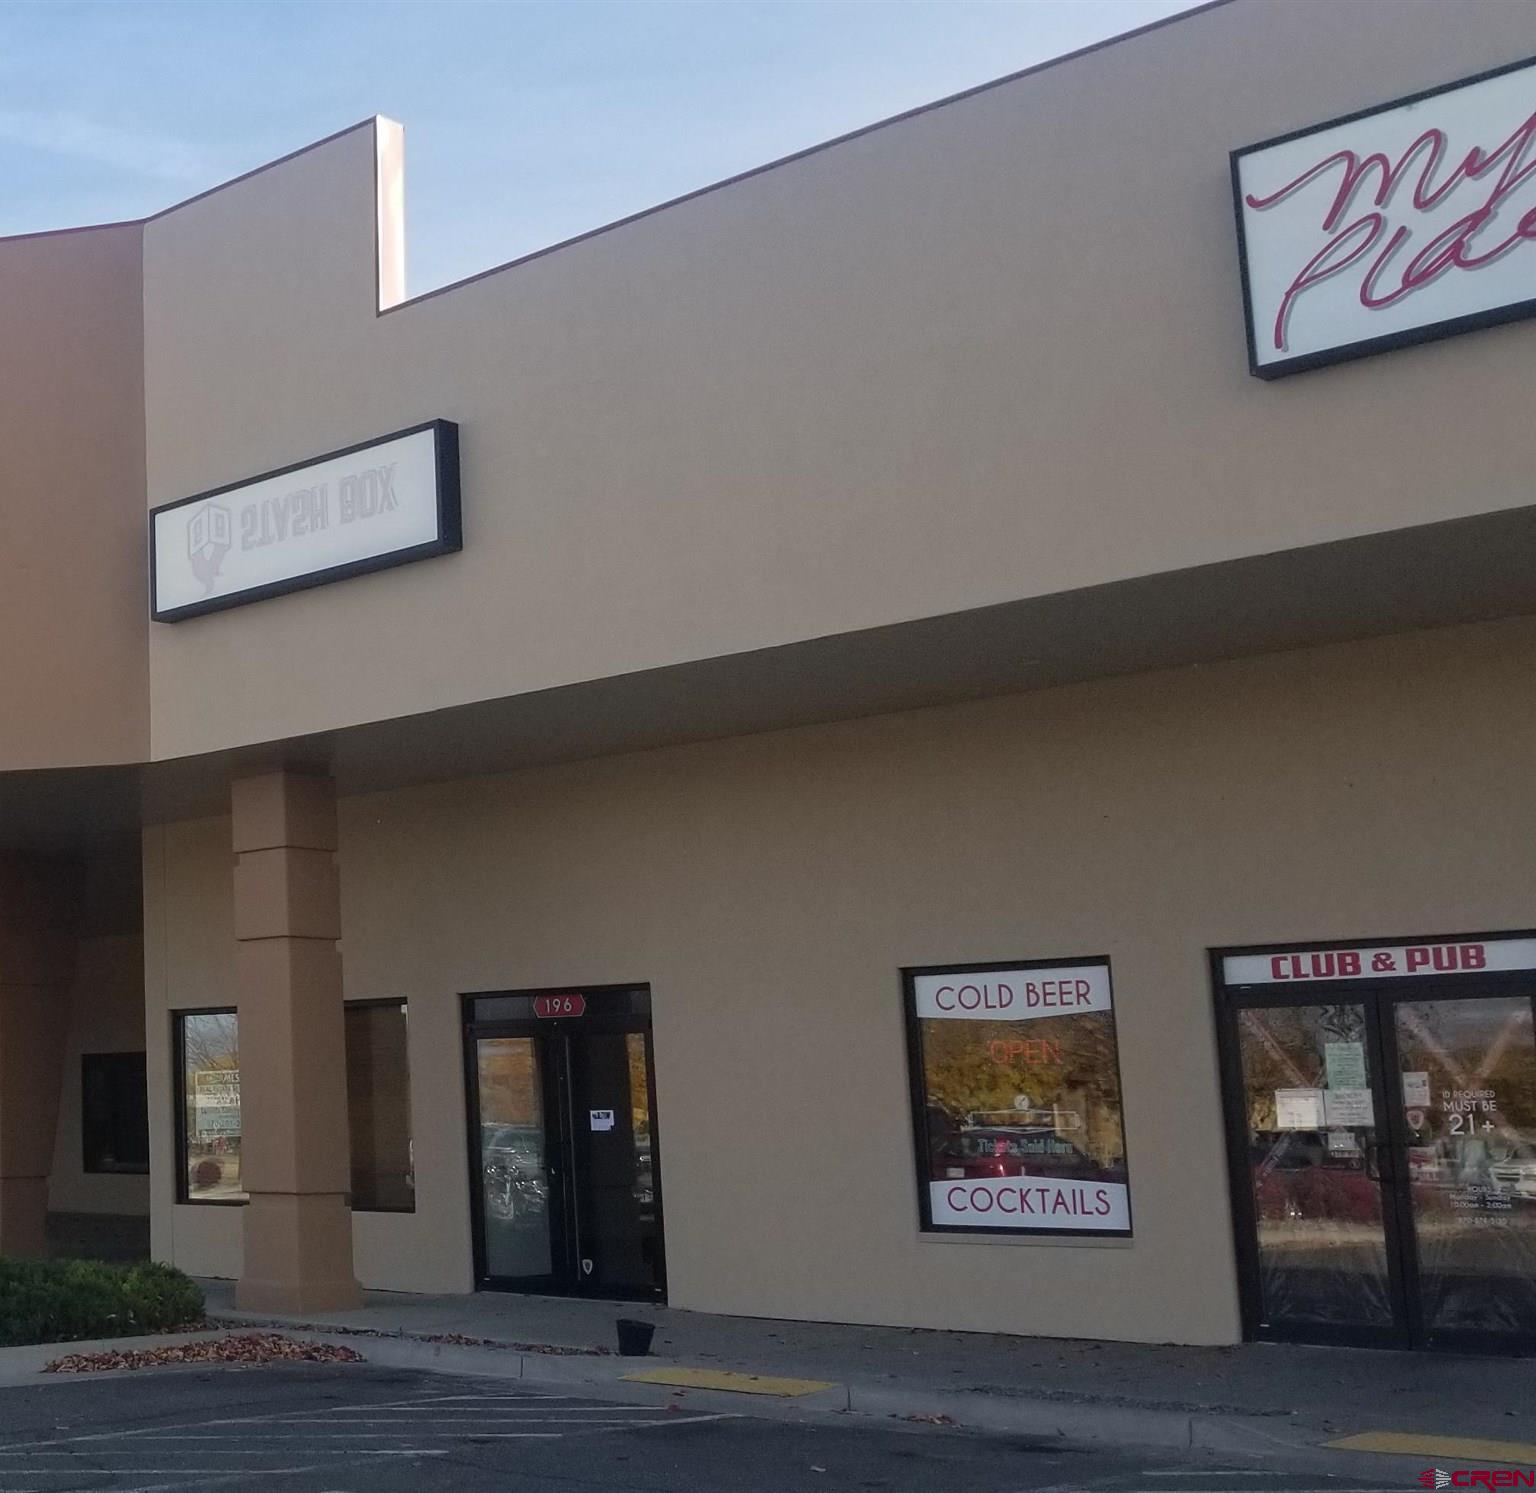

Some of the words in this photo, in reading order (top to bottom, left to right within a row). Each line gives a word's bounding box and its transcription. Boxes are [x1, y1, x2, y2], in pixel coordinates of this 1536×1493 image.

[1271, 951, 1361, 980] CLUB
[1371, 952, 1396, 973] &
[1405, 943, 1486, 973] PUB
[546, 997, 572, 1013] 196
[935, 983, 1014, 1011] COLD
[1026, 979, 1092, 1008] BEER
[988, 1039, 1064, 1066] OPEN
[1444, 1100, 1477, 1112] MUST
[1482, 1100, 1497, 1112] BE
[947, 1186, 1112, 1216] COCKTAILS
